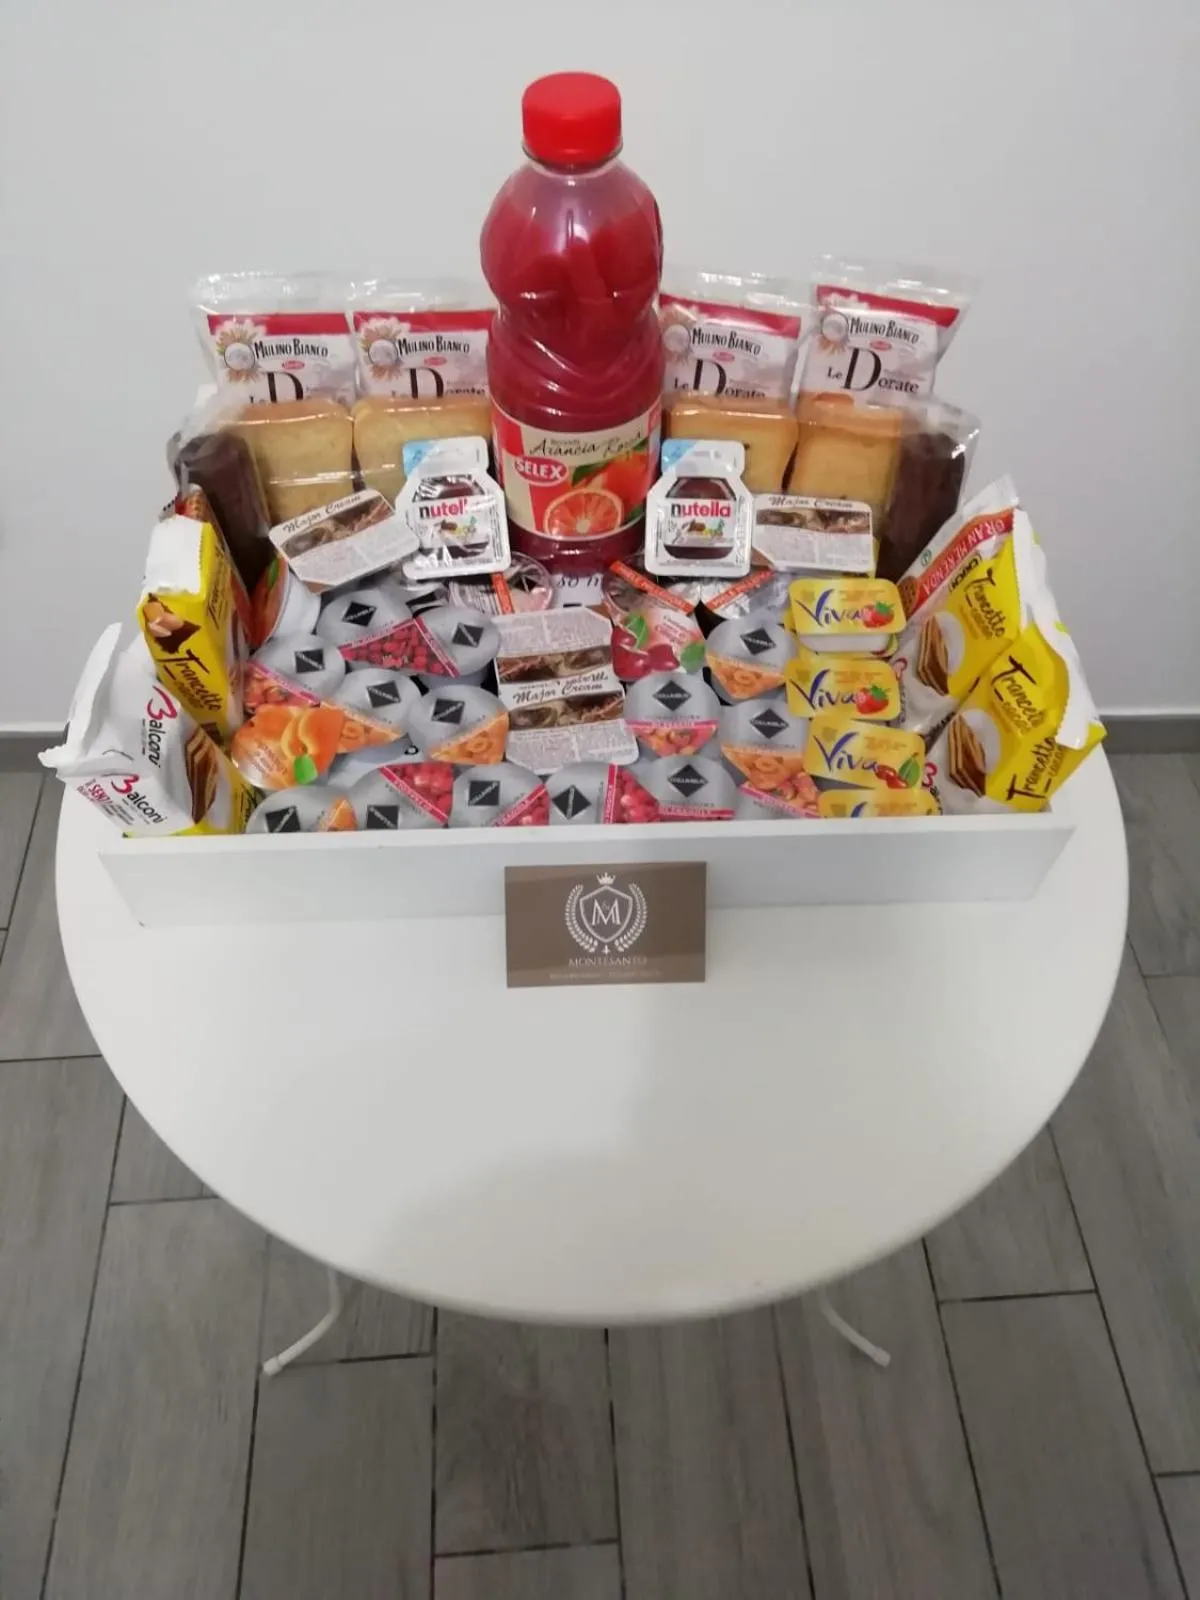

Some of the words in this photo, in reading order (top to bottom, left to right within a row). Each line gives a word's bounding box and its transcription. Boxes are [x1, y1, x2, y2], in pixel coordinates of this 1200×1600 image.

[826, 365, 843, 380] Le
[842, 346, 921, 394] Dorate
[513, 457, 563, 480] SELEX
[418, 496, 468, 520] nutel
[670, 500, 732, 518] nutella
[794, 588, 862, 628] Viva
[788, 668, 857, 711] Viva
[811, 730, 879, 774] Viva
